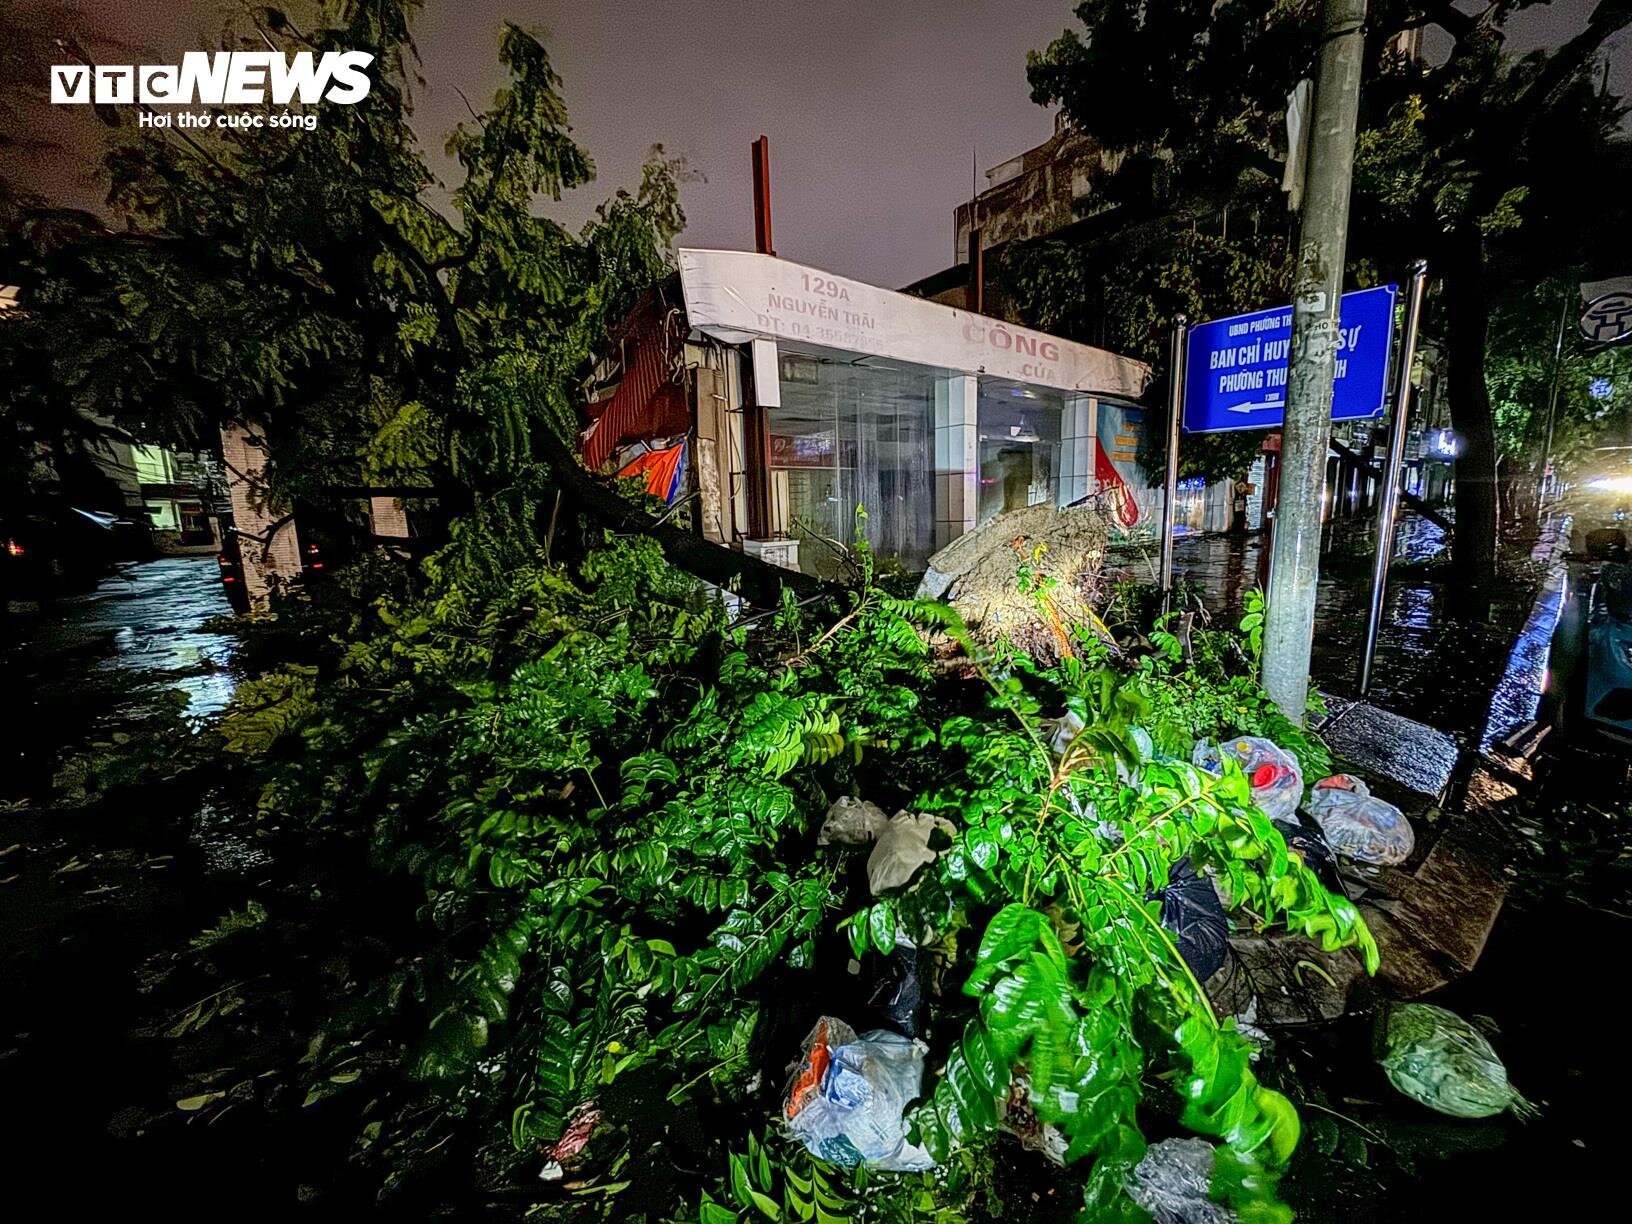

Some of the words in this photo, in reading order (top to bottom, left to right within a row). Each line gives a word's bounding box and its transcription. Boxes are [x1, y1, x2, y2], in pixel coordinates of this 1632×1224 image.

[801, 274, 850, 302] 129A
[1229, 323, 1248, 337] UBND
[1210, 348, 1236, 370] BAN
[1238, 337, 1260, 364] CHỈ
